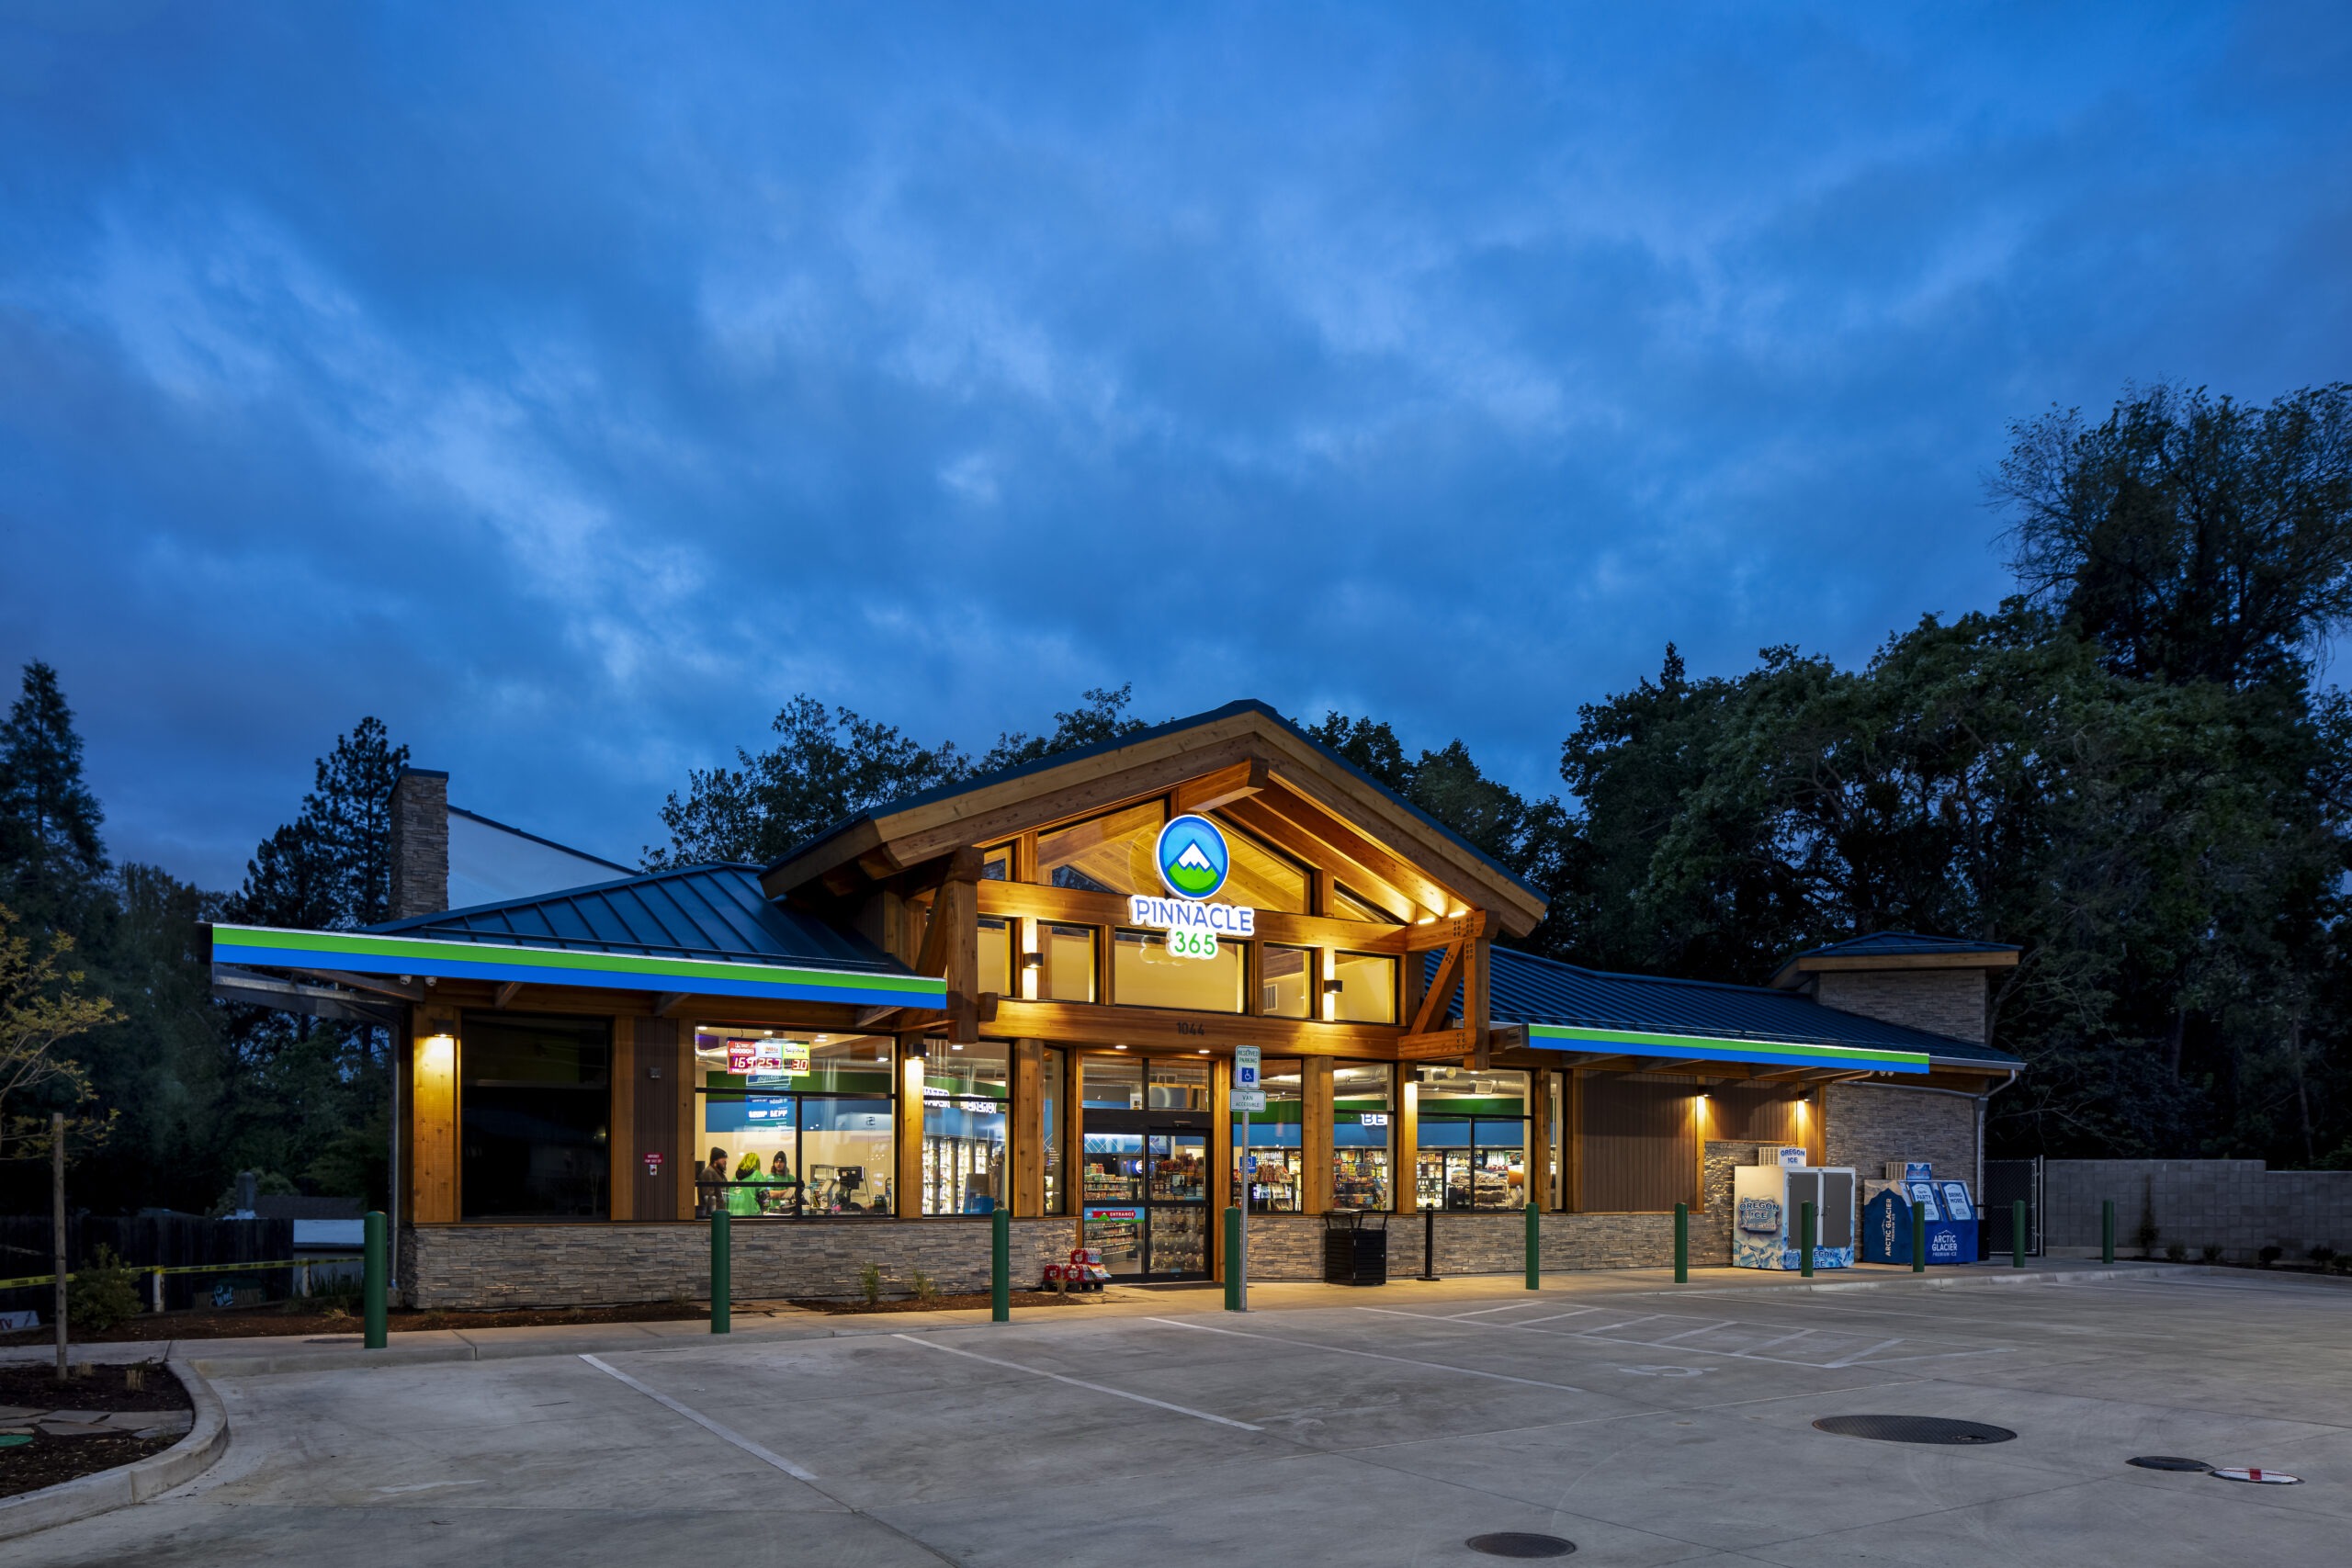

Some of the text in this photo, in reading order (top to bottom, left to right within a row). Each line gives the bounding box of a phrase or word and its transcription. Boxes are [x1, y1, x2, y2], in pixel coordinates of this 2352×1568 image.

[1135, 898, 1252, 932] PINNACLE
[1174, 931, 1216, 955] 365
[1177, 1021, 1205, 1036] 1044
[733, 1056, 753, 1068] 169
[757, 1057, 782, 1069] 257
[1780, 1148, 1805, 1157] OREGON
[1739, 1201, 1780, 1212] OREGON
[1750, 1212, 1769, 1220] ICE
[1933, 1235, 1956, 1244] ARCTIC
[1931, 1243, 1958, 1251] GLACIER
[1813, 1250, 1835, 1258] EGON
